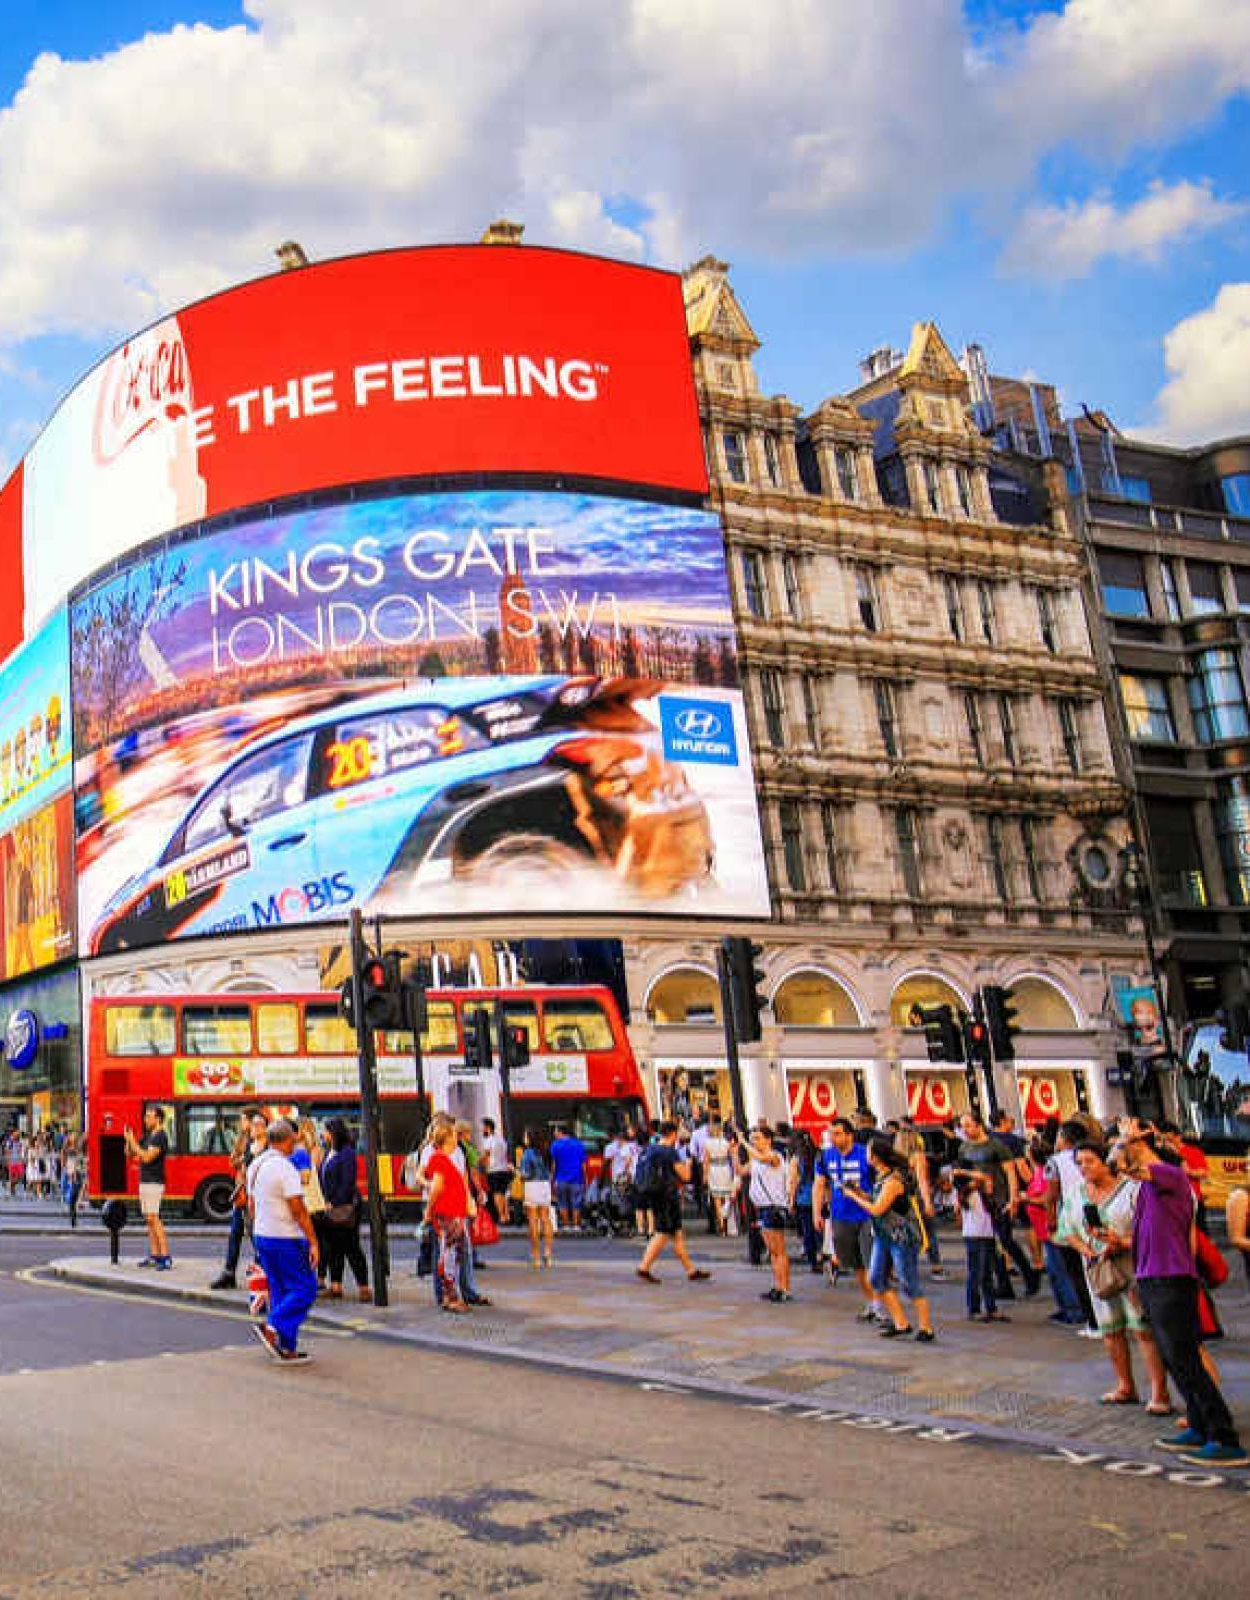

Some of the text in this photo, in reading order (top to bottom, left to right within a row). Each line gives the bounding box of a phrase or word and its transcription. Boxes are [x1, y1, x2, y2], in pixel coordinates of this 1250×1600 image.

[226, 371, 338, 433] THE
[209, 527, 557, 615] KINGS GATE
[211, 588, 622, 671] LONDON SW1
[251, 870, 355, 926] MOBIS
